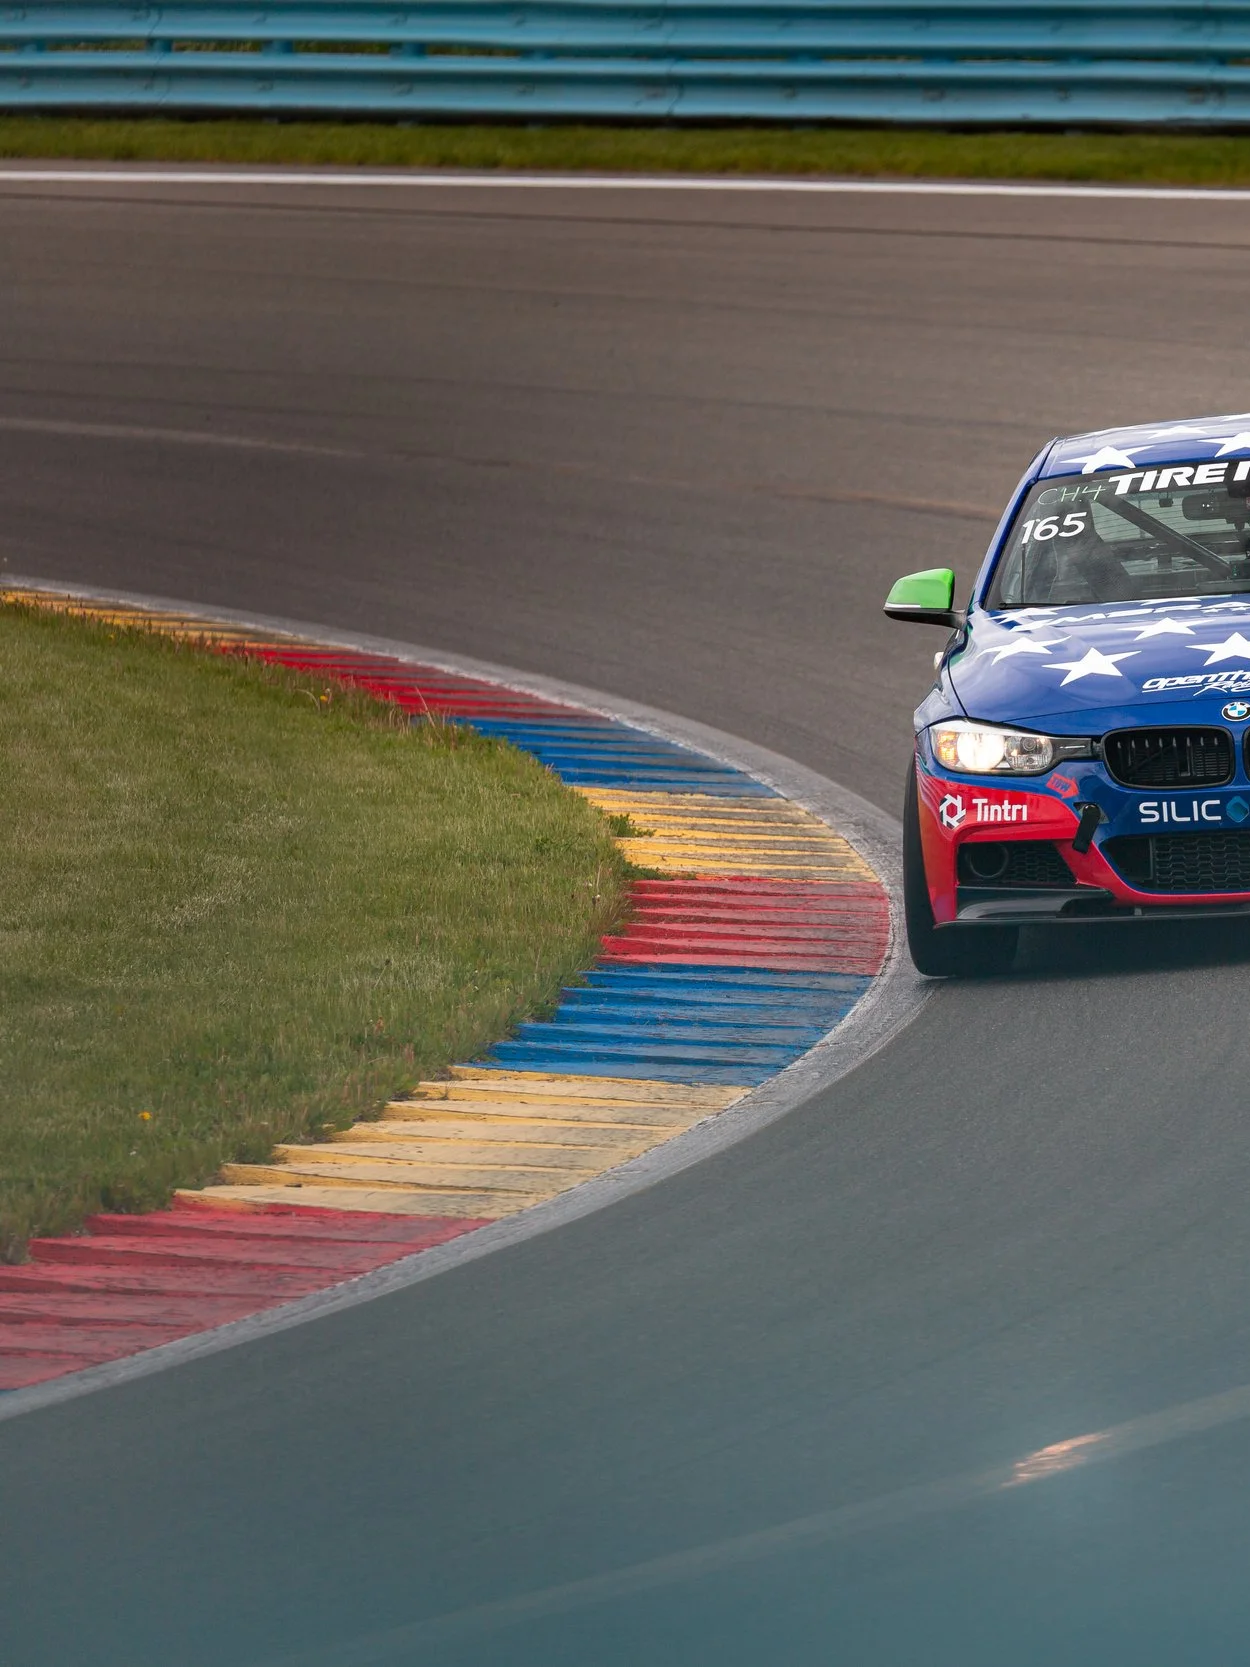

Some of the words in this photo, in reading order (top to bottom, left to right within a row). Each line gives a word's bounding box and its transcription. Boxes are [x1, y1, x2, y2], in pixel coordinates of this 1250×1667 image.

[1109, 462, 1229, 496] TIRE
[1022, 512, 1087, 544] 165
[972, 799, 1027, 821] Tintri
